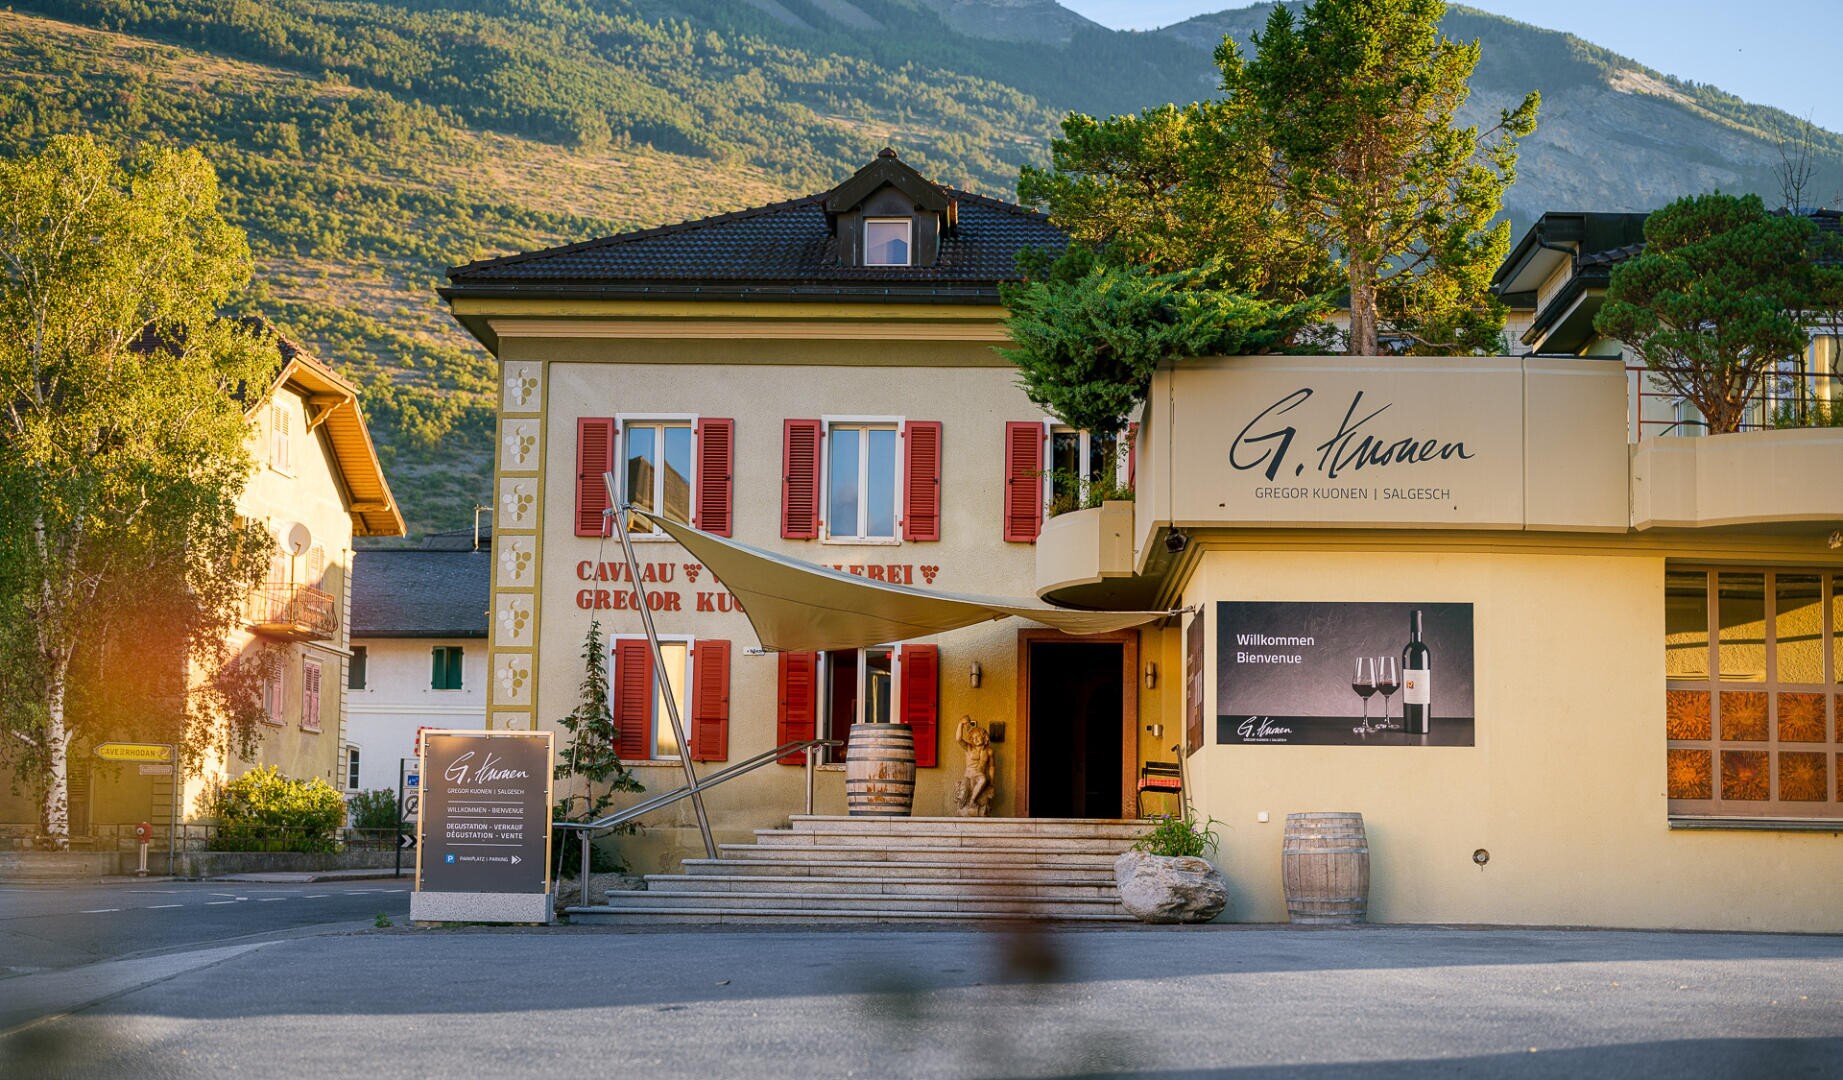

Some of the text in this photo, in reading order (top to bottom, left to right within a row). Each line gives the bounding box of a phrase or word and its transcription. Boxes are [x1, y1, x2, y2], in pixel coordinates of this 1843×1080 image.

[1228, 387, 1314, 482] G.
[1255, 487, 1309, 499] GREGOR
[1313, 487, 1368, 499] KUONEN
[1383, 487, 1450, 500] SALGESCH
[1236, 634, 1315, 646] Willkommen
[1236, 652, 1302, 664] Bienvenue
